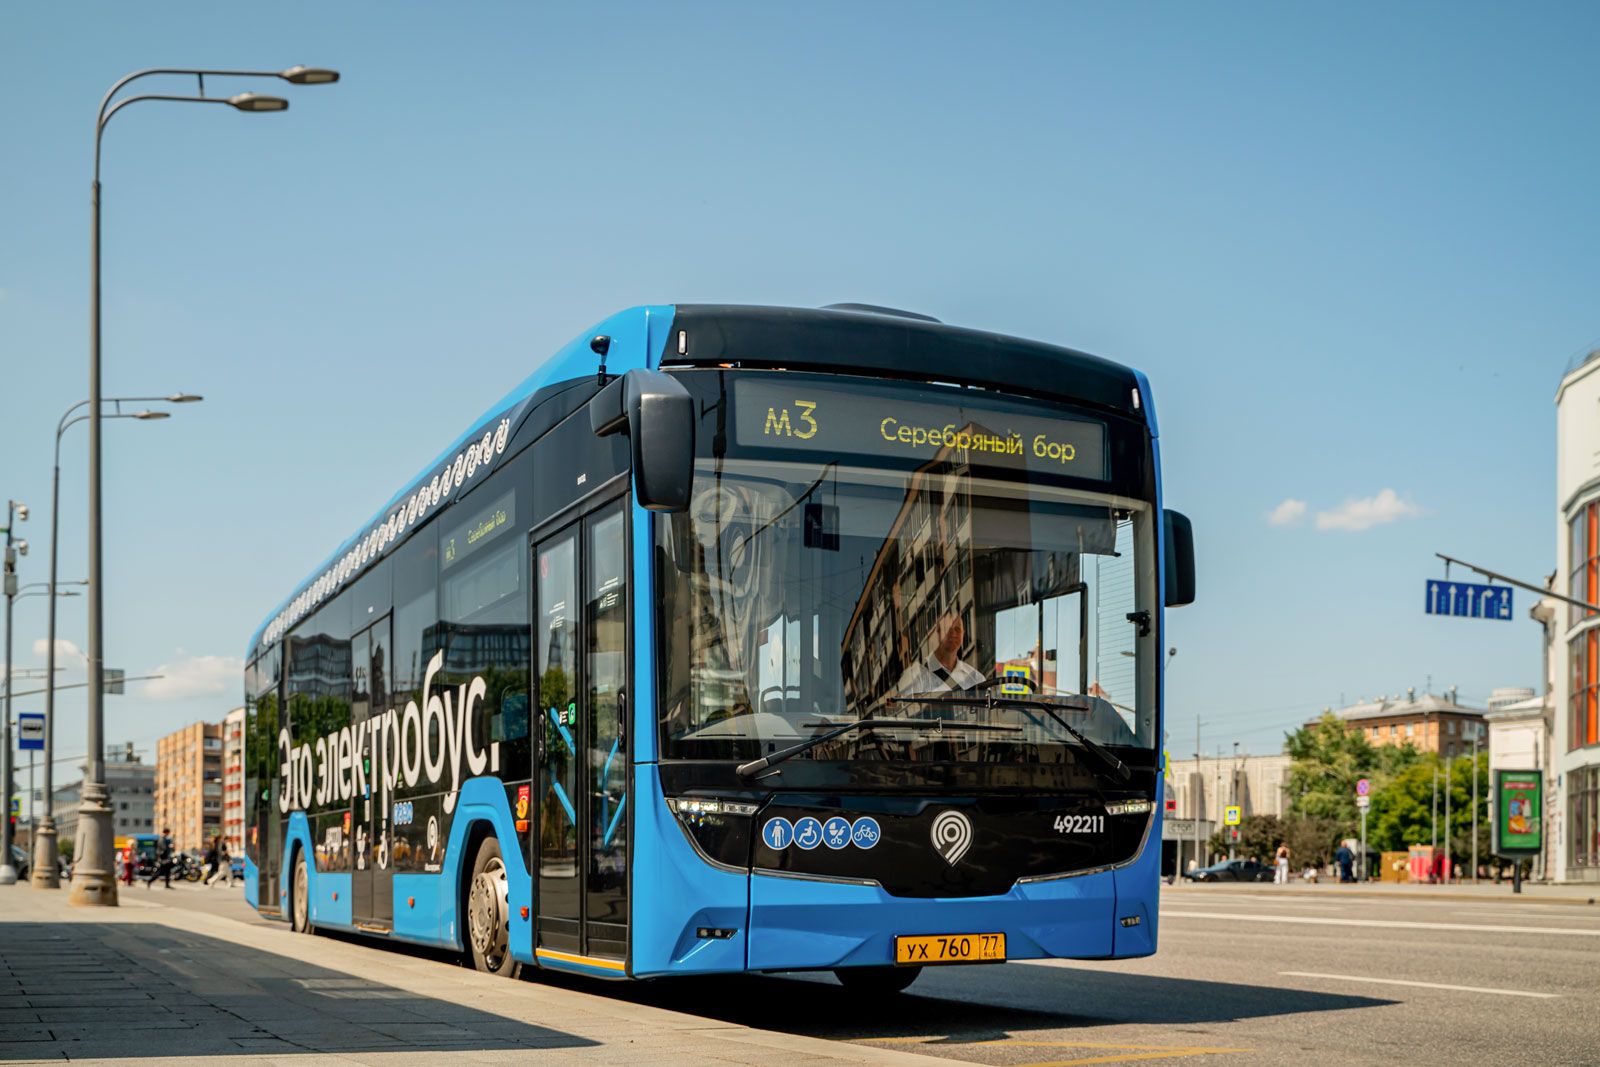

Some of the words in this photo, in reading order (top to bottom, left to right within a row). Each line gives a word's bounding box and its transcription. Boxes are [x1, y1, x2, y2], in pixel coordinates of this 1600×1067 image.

[880, 417, 1023, 456] Серебряный
[1033, 435, 1076, 463] бор
[279, 728, 312, 813] Это
[316, 648, 500, 819] электробус.
[1053, 815, 1104, 833] 492211
[937, 938, 970, 958] 760
[981, 936, 998, 950] 77
